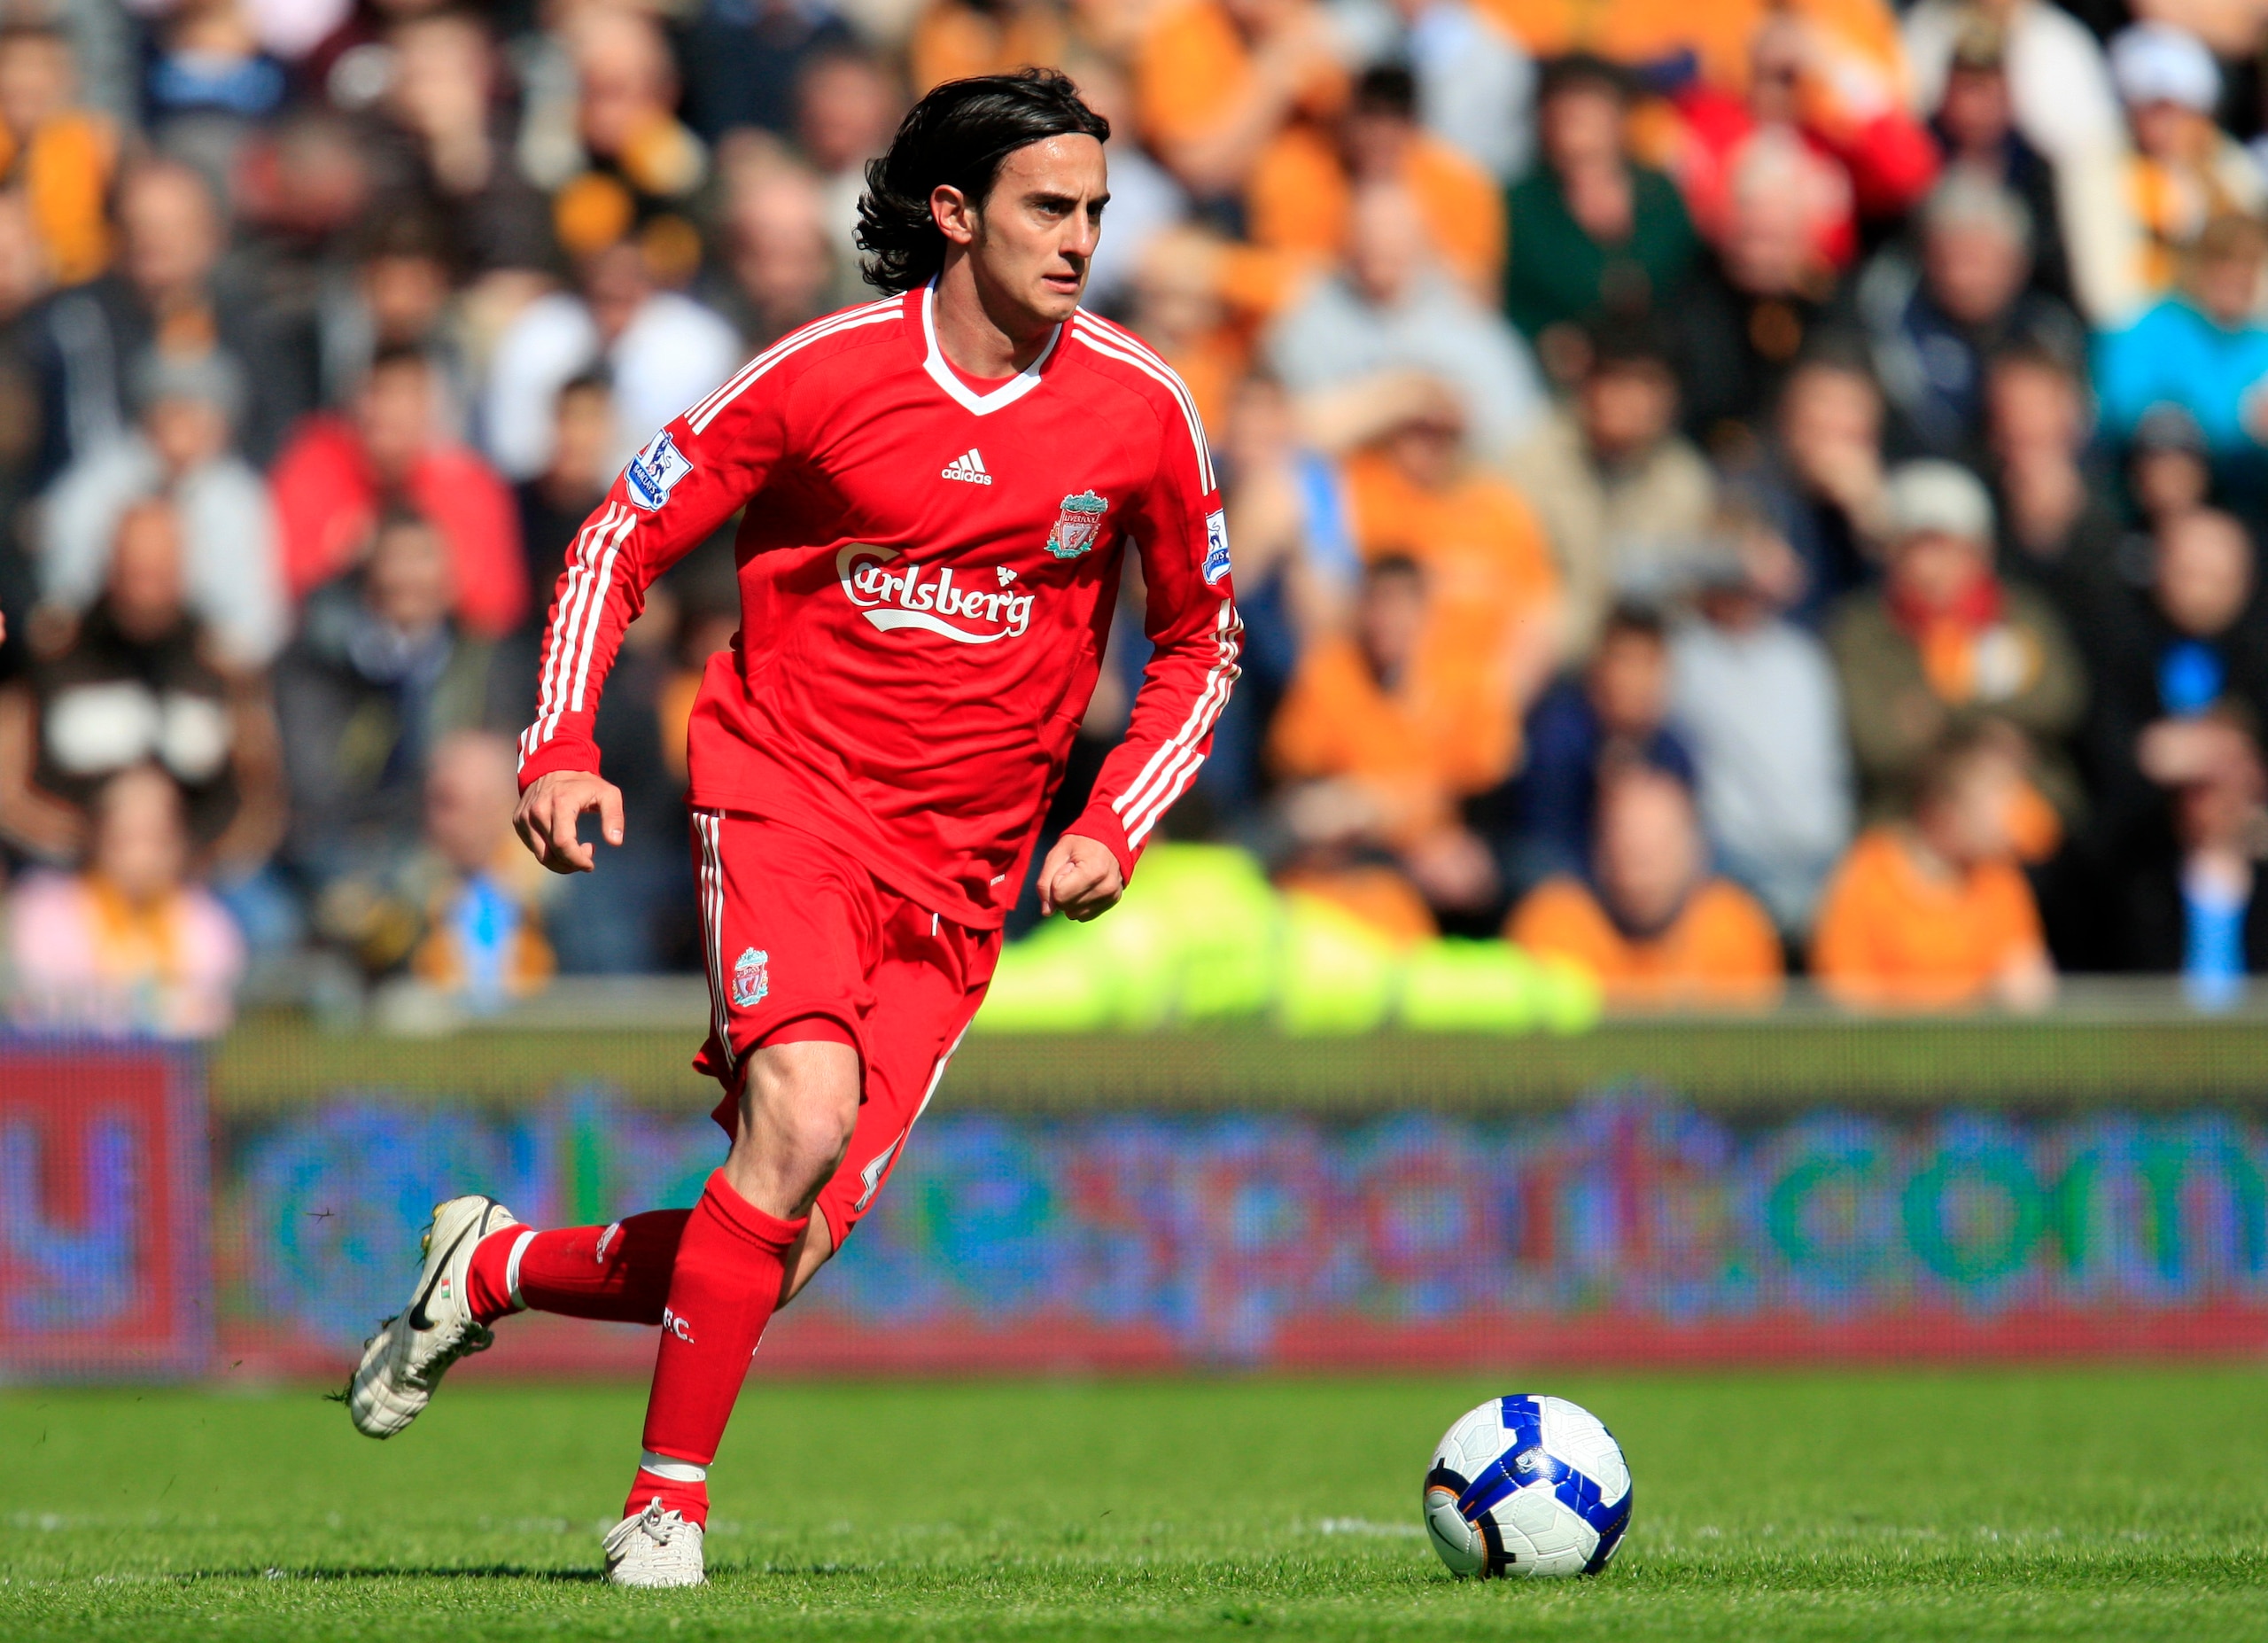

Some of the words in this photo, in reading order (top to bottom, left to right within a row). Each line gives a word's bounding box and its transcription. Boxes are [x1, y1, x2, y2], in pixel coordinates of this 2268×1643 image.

[633, 464, 656, 494] BARCLAYS
[941, 468, 992, 486] adidas
[835, 542, 1036, 637] Carlsberg
